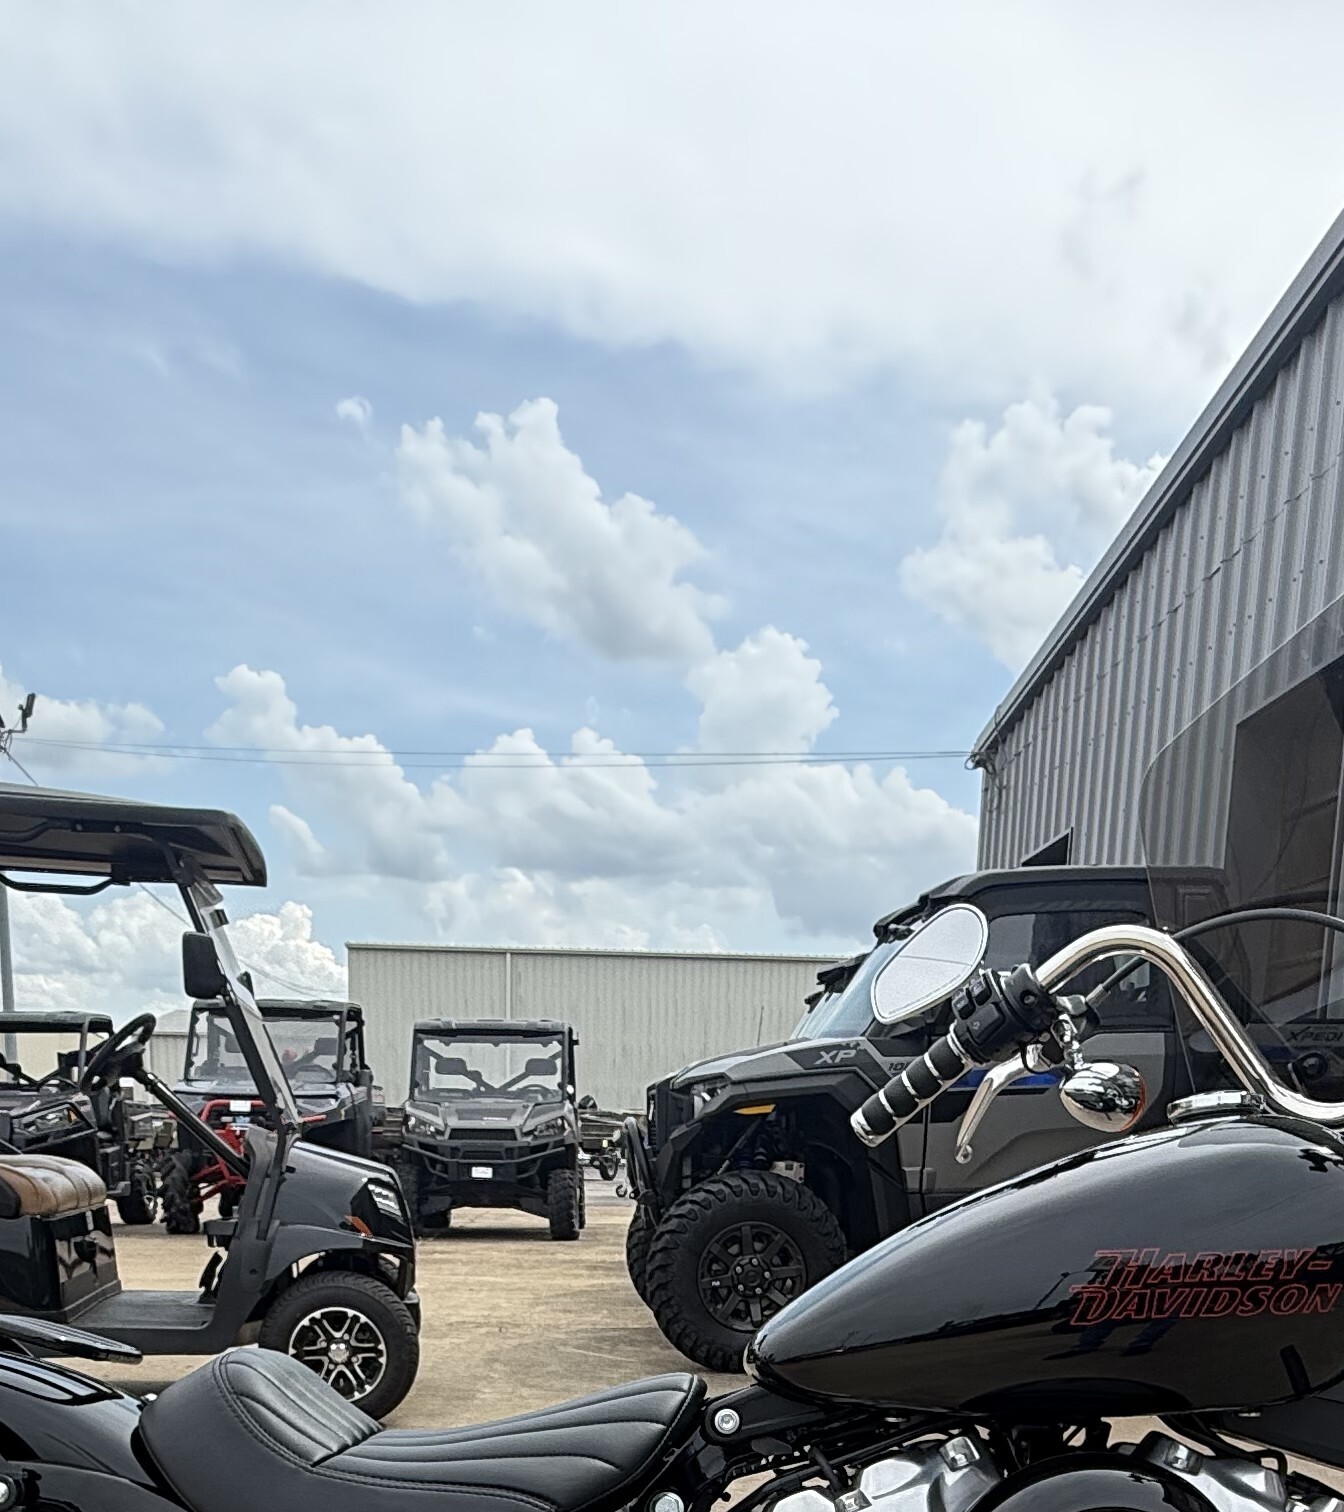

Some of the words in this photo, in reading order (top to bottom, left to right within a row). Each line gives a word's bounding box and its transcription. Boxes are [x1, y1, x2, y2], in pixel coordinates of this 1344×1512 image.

[814, 1049, 857, 1065] XP
[1094, 1248, 1334, 1289] HARLEY-
[1069, 1283, 1343, 1326] DAVIDSON
